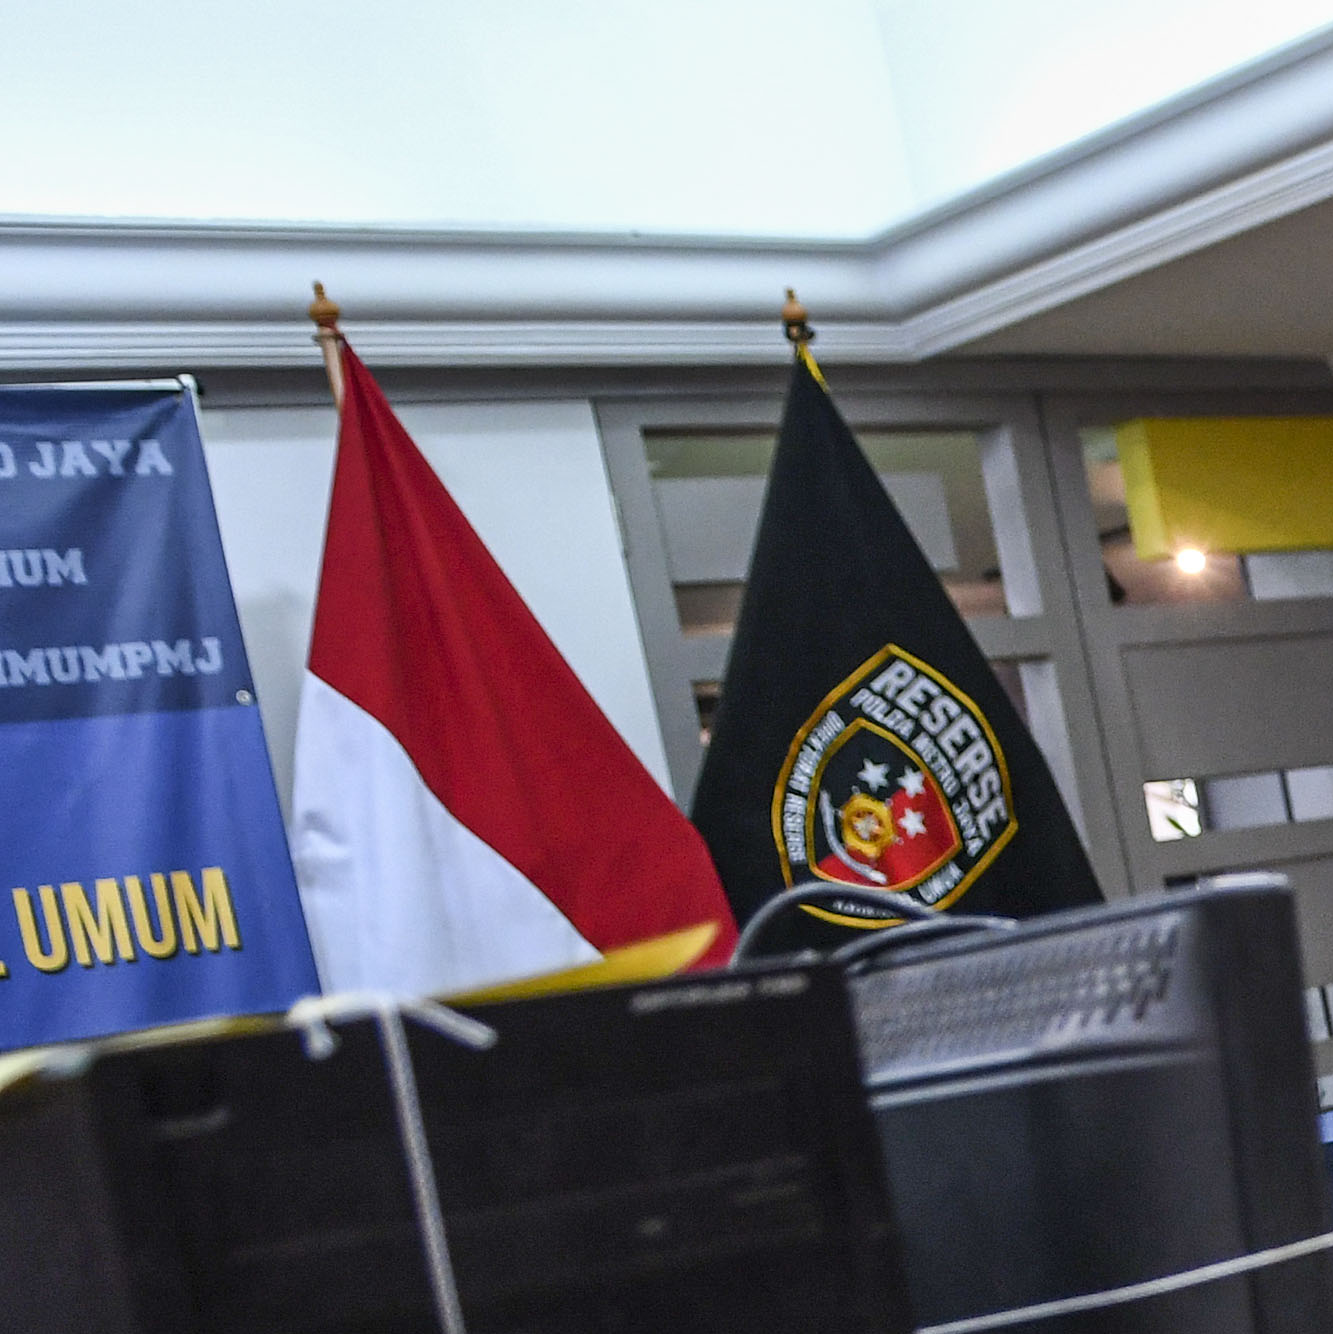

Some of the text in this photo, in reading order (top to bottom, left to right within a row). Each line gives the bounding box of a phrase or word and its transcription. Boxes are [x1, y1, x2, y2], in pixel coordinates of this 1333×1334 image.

[28, 439, 174, 478] JAYA
[870, 658, 1009, 842] RESERSE
[12, 866, 241, 973] UMUM
